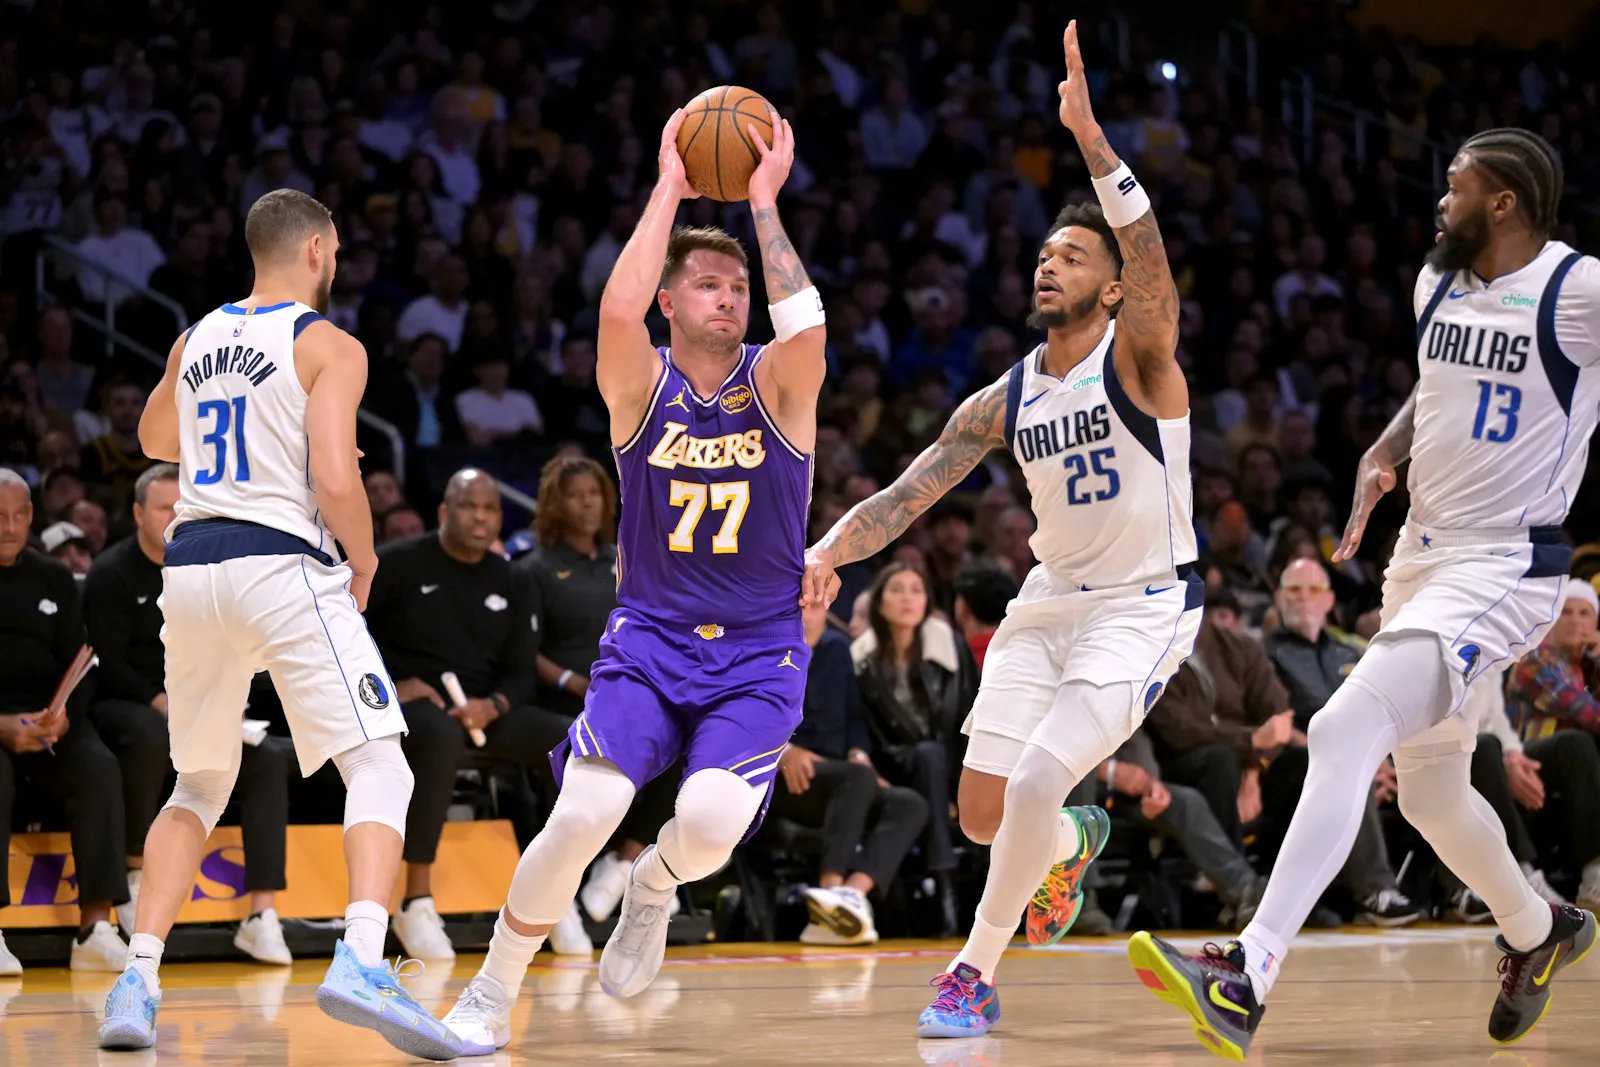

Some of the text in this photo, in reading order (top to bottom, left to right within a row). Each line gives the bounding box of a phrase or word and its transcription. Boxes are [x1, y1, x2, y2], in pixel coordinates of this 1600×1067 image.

[1502, 294, 1537, 308] chime
[182, 345, 277, 394] THOMPSON
[1427, 321, 1531, 374] DALLAS
[722, 391, 750, 406] bibigo
[1072, 374, 1102, 391] chime
[1017, 404, 1111, 463] DALLAS
[1472, 379, 1523, 443] 13
[193, 395, 250, 485] 31
[647, 421, 766, 470] LAKERS
[1063, 446, 1121, 506] 25
[668, 479, 751, 554] 77
